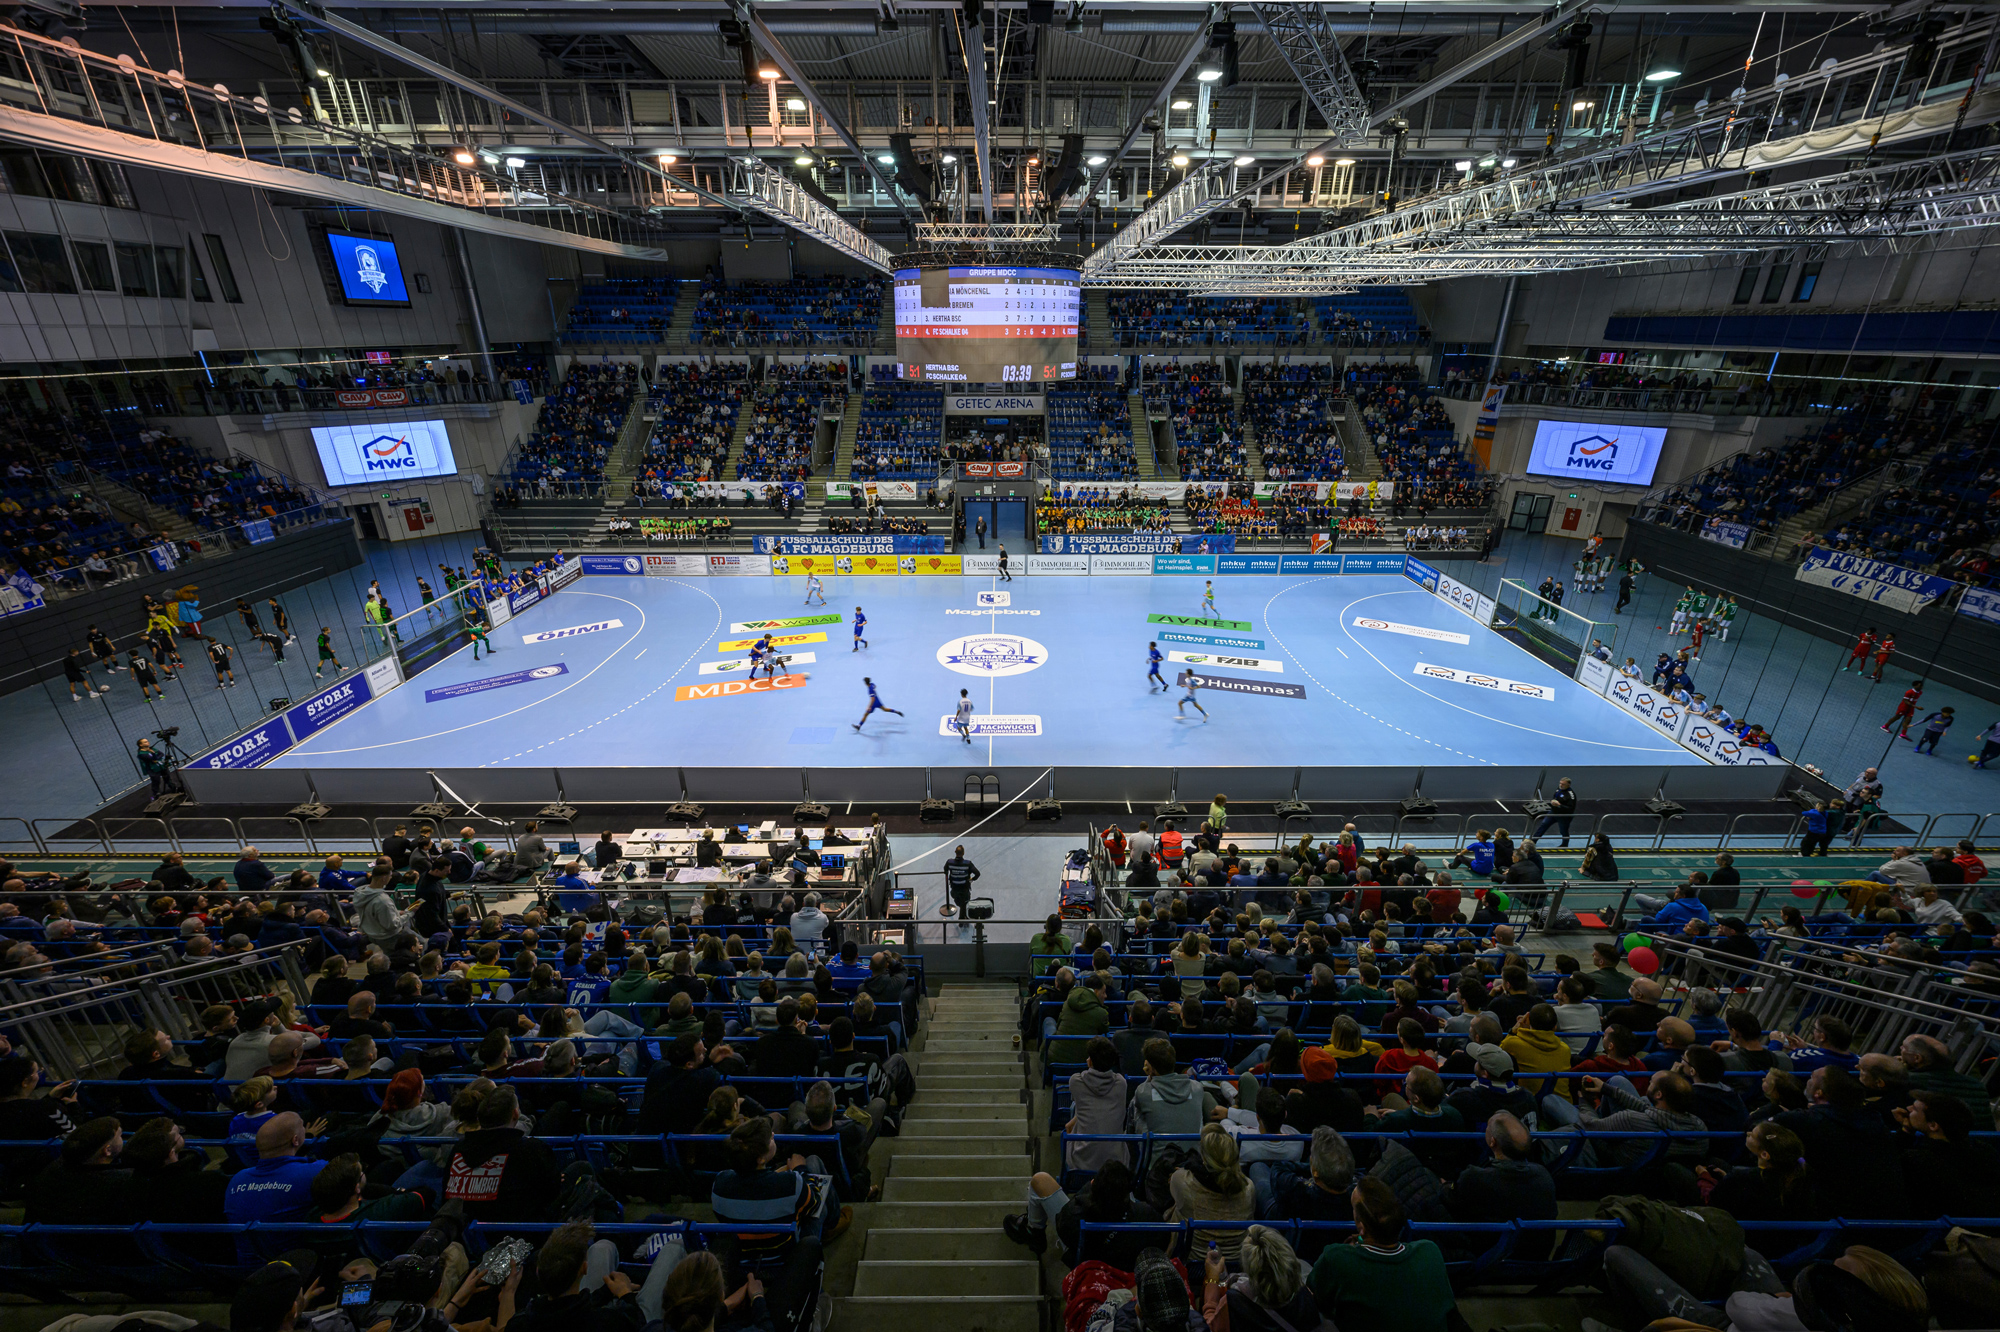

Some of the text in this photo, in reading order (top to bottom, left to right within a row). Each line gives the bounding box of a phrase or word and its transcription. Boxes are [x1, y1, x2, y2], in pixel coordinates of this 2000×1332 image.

[956, 286, 991, 295] MÖNCHENGL.
[909, 365, 920, 378] 5:1
[947, 364, 959, 372] BSC
[1002, 365, 1032, 381] 03:39
[1043, 365, 1056, 378] 5:1
[926, 372, 932, 380] FC
[343, 392, 367, 402] SAW
[380, 391, 402, 400] SAW
[956, 398, 1033, 409] GETEC ARENA
[367, 457, 416, 471] MWG
[970, 464, 989, 472] SAW
[1001, 464, 1019, 472] SAW
[1566, 456, 1614, 471] MWG
[1730, 529, 1746, 538] FANS
[780, 536, 893, 545] FUSSBALLSCHULE DES
[1069, 536, 1182, 544] FUSSBALLSCHULE DES
[781, 544, 893, 554] 1. FC MAGDEBURG
[1069, 544, 1174, 554] 1. FC MAGDEBUR
[1440, 588, 1449, 597] MWG
[1451, 595, 1460, 604] MWG
[1462, 602, 1473, 611] MWG
[782, 615, 839, 626] WOBAU
[1158, 615, 1241, 629] AVNET
[537, 623, 609, 641] ÖHMI
[1217, 656, 1260, 667] FAB
[1423, 670, 1455, 680] MWG
[688, 676, 793, 699] MDCC
[1207, 678, 1295, 696] Humanas
[1465, 679, 1498, 689] MWG
[1508, 687, 1544, 698] MWG
[1612, 689, 1630, 705] MWG
[306, 683, 354, 717] STORK
[310, 693, 356, 722] UNTERNEHMENSGRUPPE
[1633, 702, 1652, 718] MWG
[1655, 716, 1676, 732] MWG
[209, 730, 270, 769] STORK
[1688, 735, 1711, 753] MWG
[569, 990, 591, 1006] 10
[236, 1184, 247, 1193] FC
[247, 1181, 293, 1193] Magdeburg
[459, 1176, 500, 1194] X UMBRO
